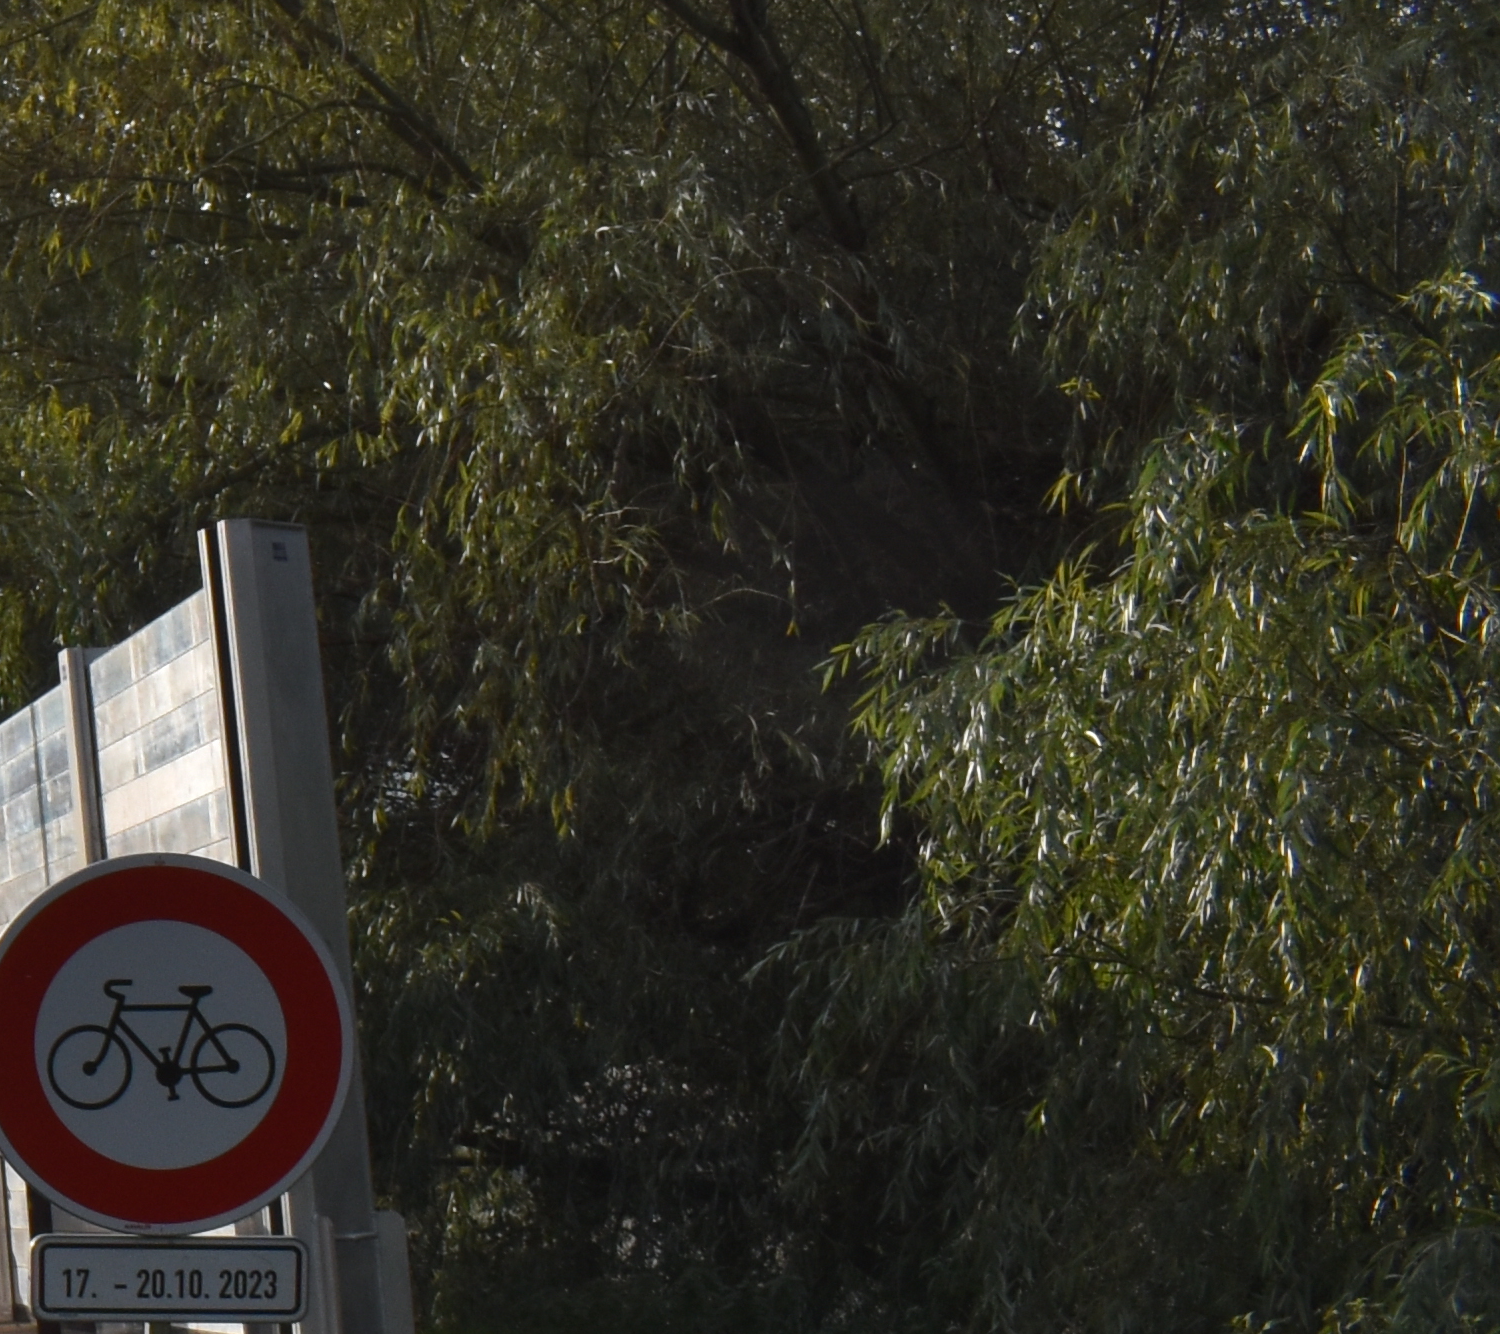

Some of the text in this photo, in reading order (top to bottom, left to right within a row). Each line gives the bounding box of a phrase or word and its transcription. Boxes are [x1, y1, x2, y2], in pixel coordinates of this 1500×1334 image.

[62, 1268, 97, 1298] 17.
[136, 1269, 210, 1299] 20.10.
[219, 1269, 278, 1300] 2023
